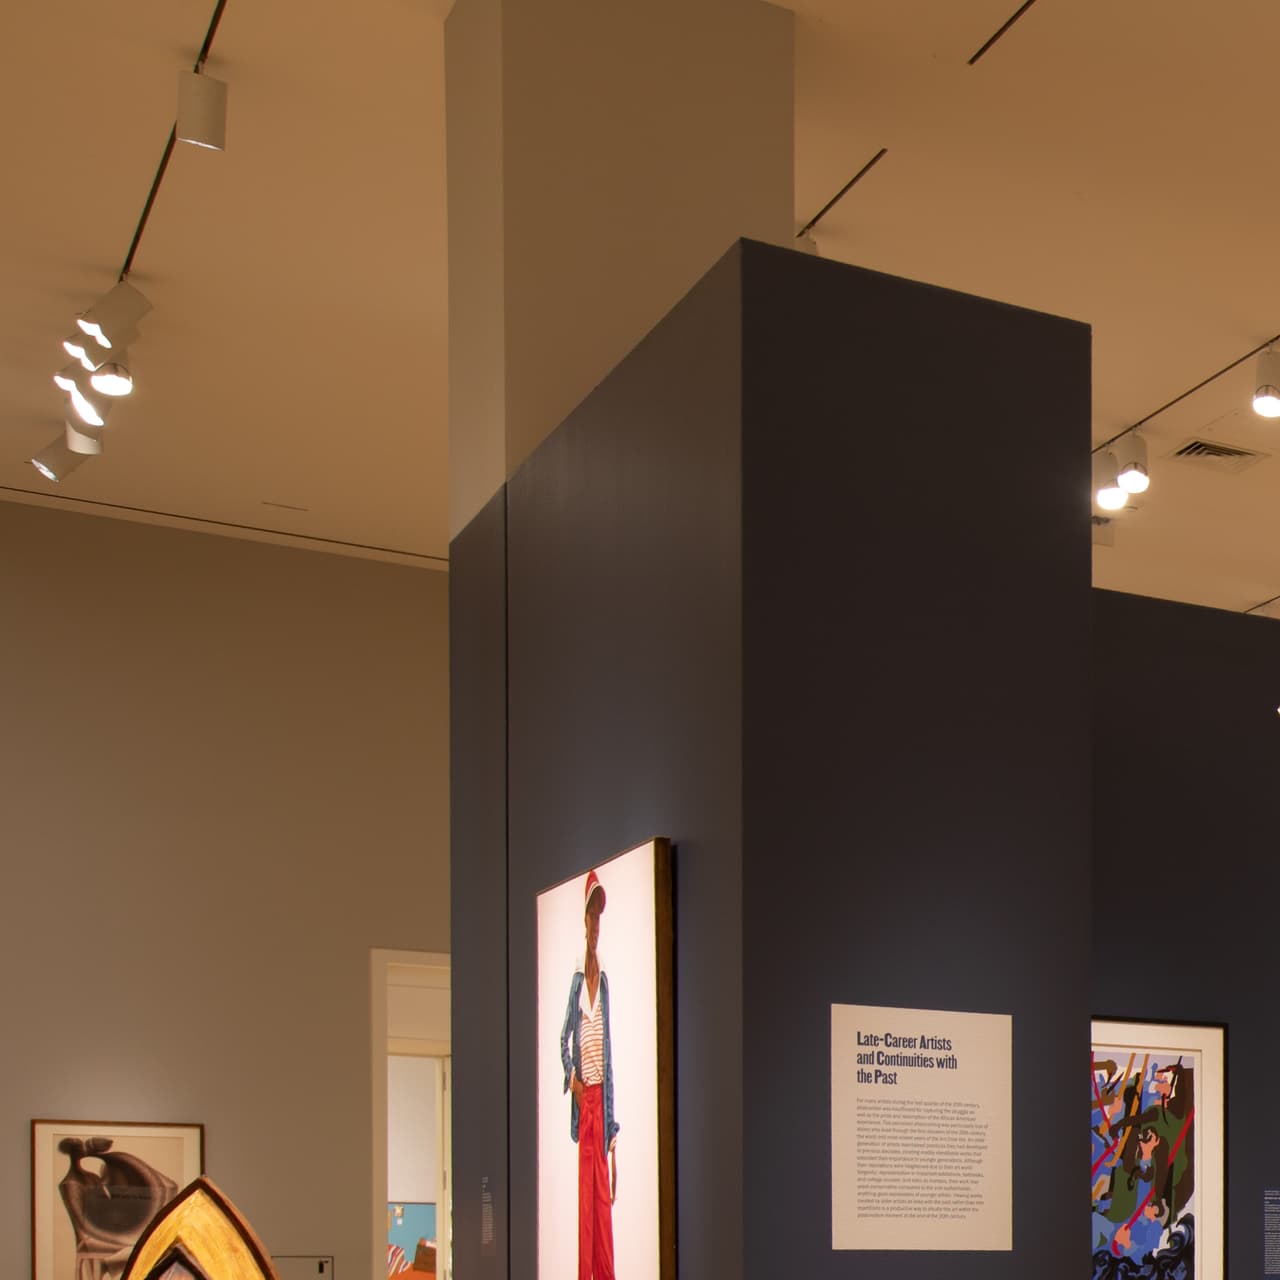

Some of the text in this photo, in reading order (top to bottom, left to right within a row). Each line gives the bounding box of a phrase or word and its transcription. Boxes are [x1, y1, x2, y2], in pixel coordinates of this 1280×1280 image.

[857, 1031, 952, 1051] Late-Career Artists
[856, 1051, 958, 1070] and Continuities with
[856, 1068, 898, 1085] the Past
